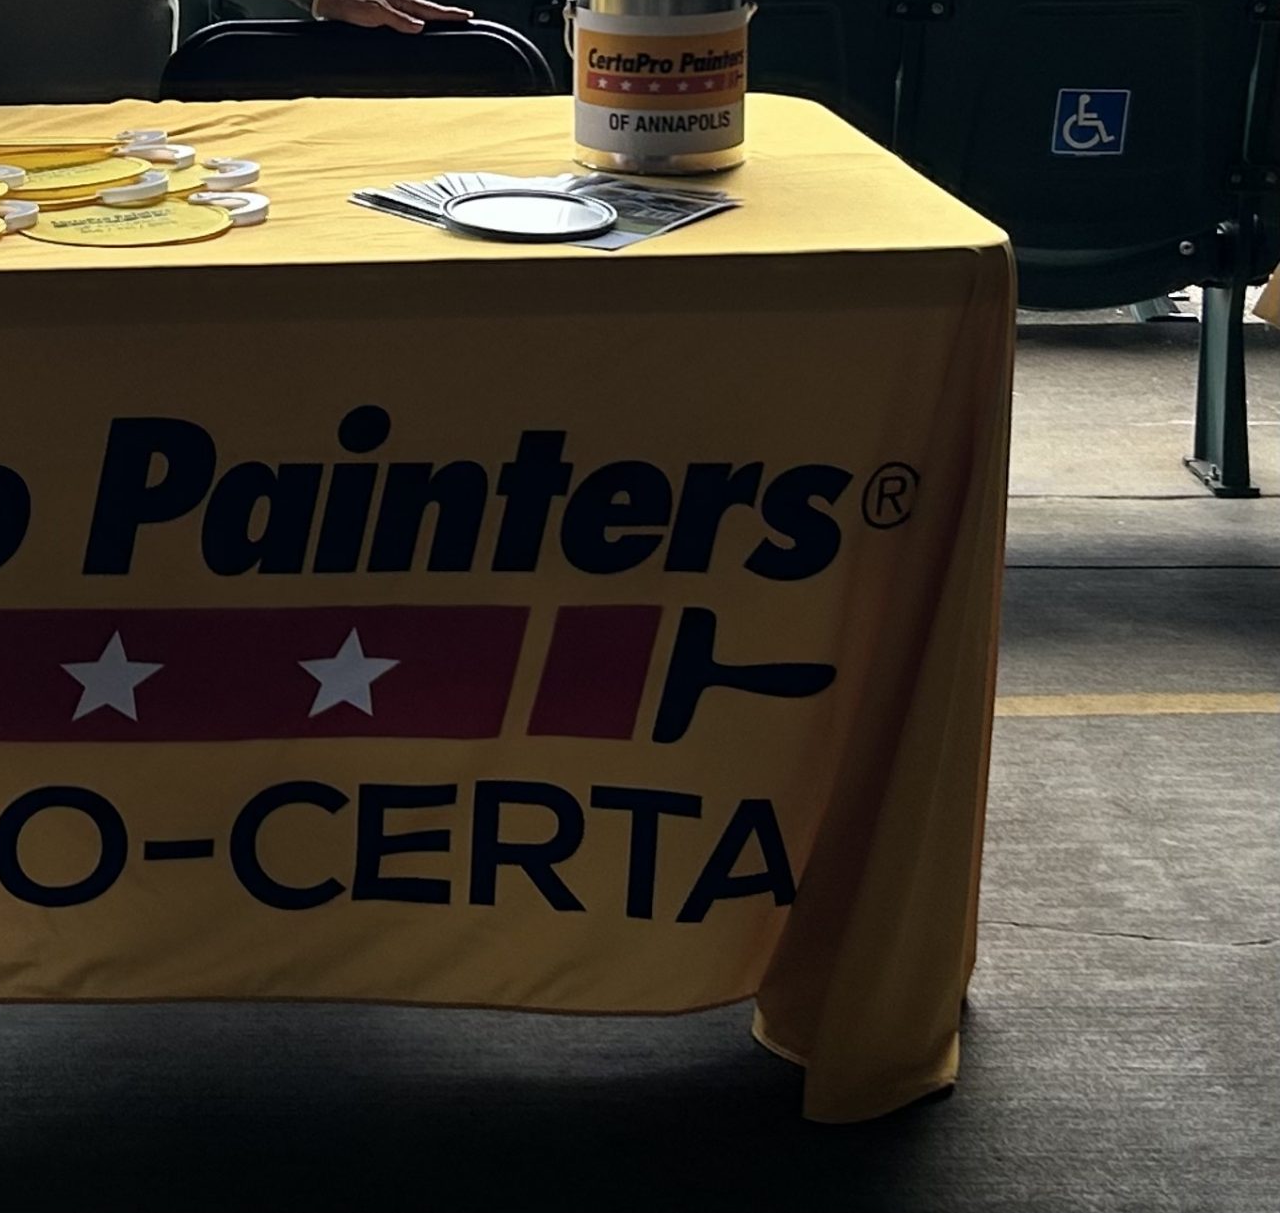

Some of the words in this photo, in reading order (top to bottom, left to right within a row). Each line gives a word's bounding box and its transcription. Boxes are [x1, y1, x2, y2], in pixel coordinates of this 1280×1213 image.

[588, 47, 673, 74] CertaPro
[678, 48, 744, 74] Painters
[609, 112, 630, 131] OF
[634, 110, 731, 133] ANNAPOLIS
